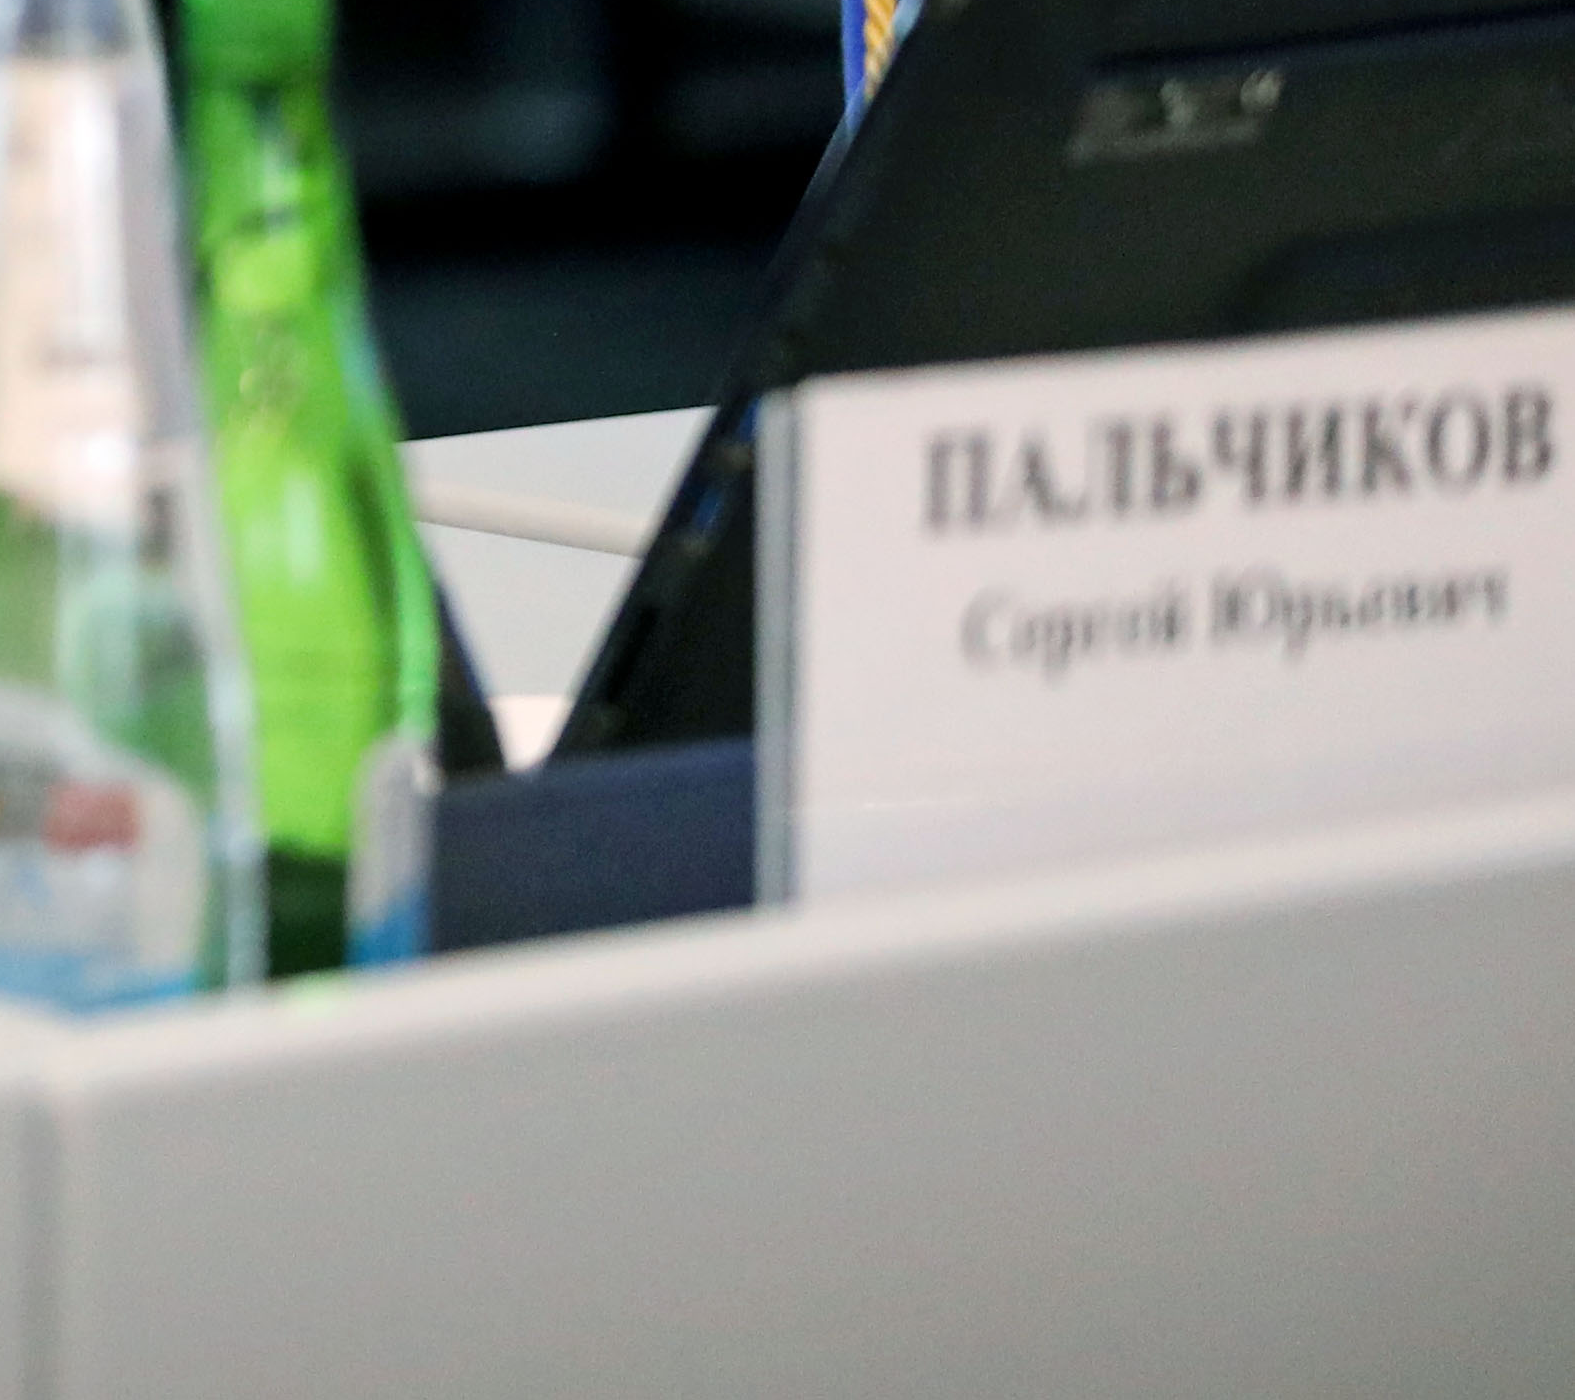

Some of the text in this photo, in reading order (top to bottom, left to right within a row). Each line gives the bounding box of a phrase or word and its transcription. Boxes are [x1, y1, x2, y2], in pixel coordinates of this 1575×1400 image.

[921, 383, 1558, 534] ПАЛЬЧИКОВ
[962, 563, 1511, 683] Сергей Юрьевич
